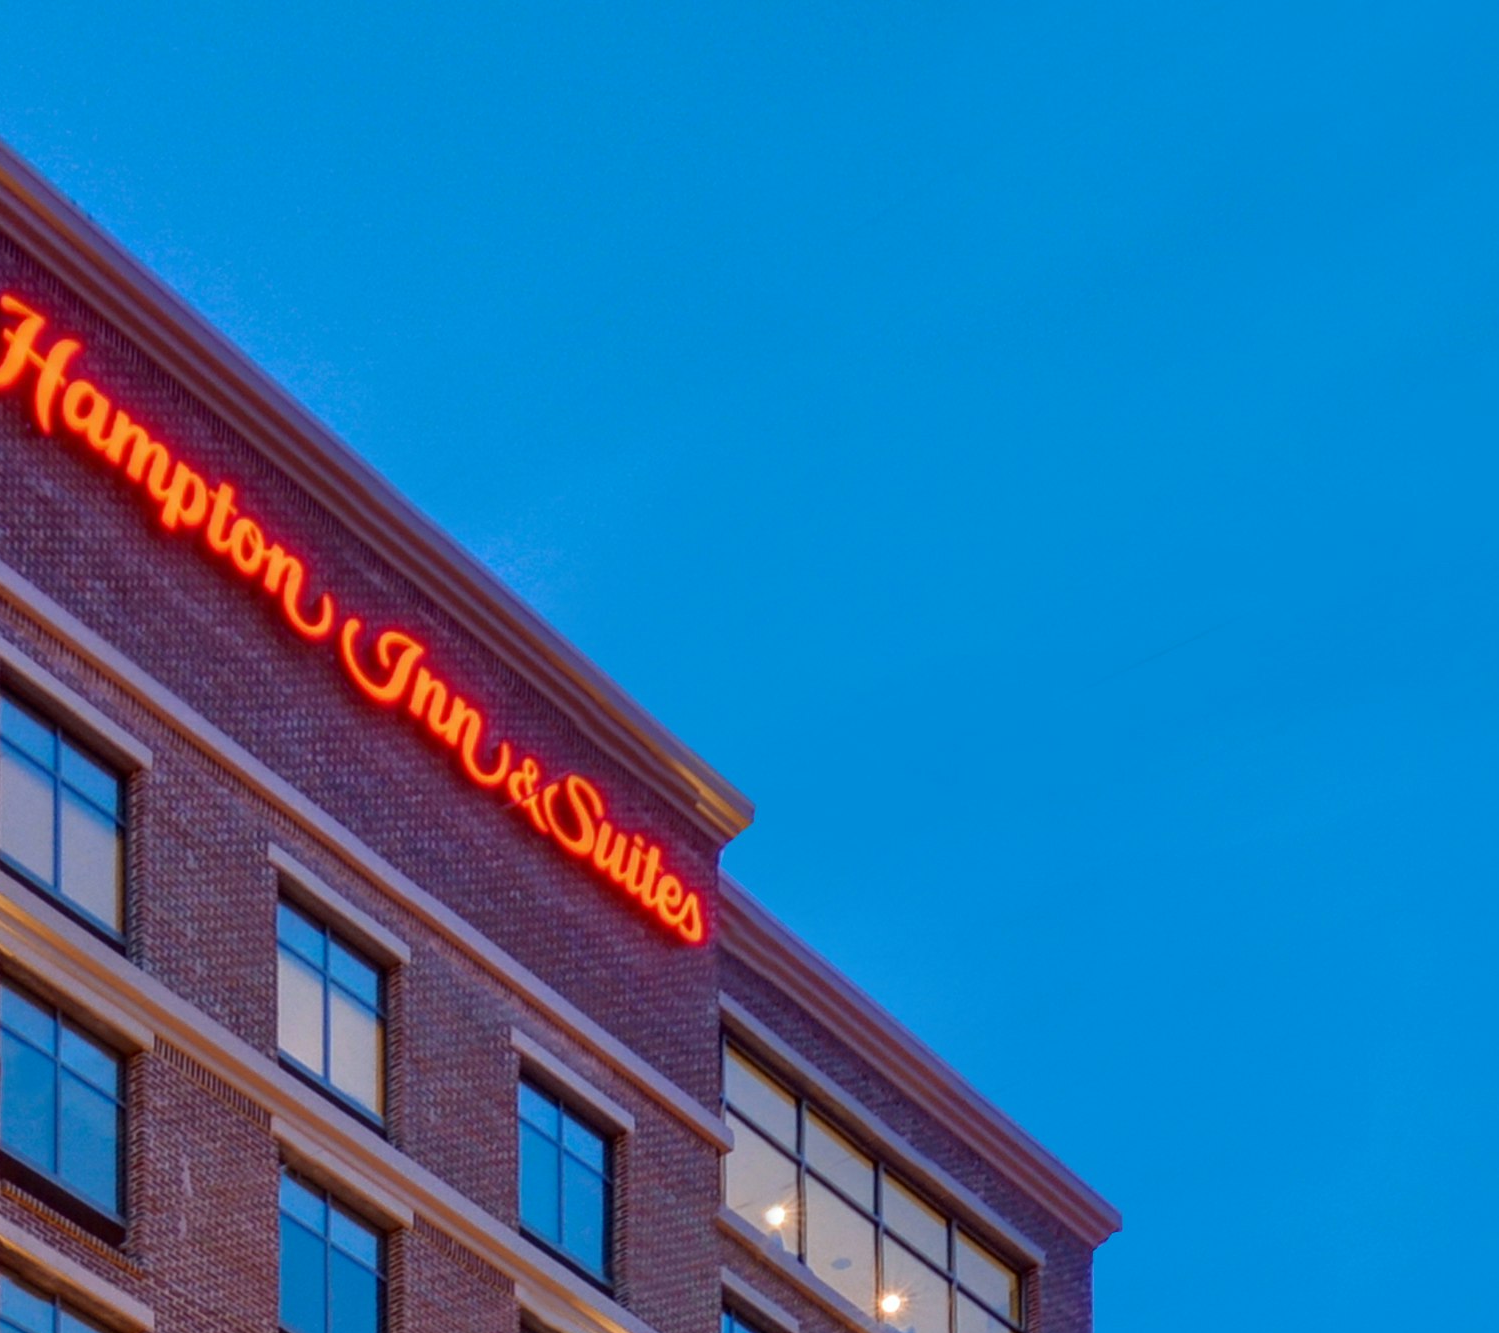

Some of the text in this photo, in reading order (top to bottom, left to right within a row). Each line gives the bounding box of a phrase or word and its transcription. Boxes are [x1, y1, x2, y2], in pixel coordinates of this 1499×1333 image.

[340, 616, 512, 788] Inn
[506, 755, 548, 833] &
[541, 773, 705, 944] Suites
